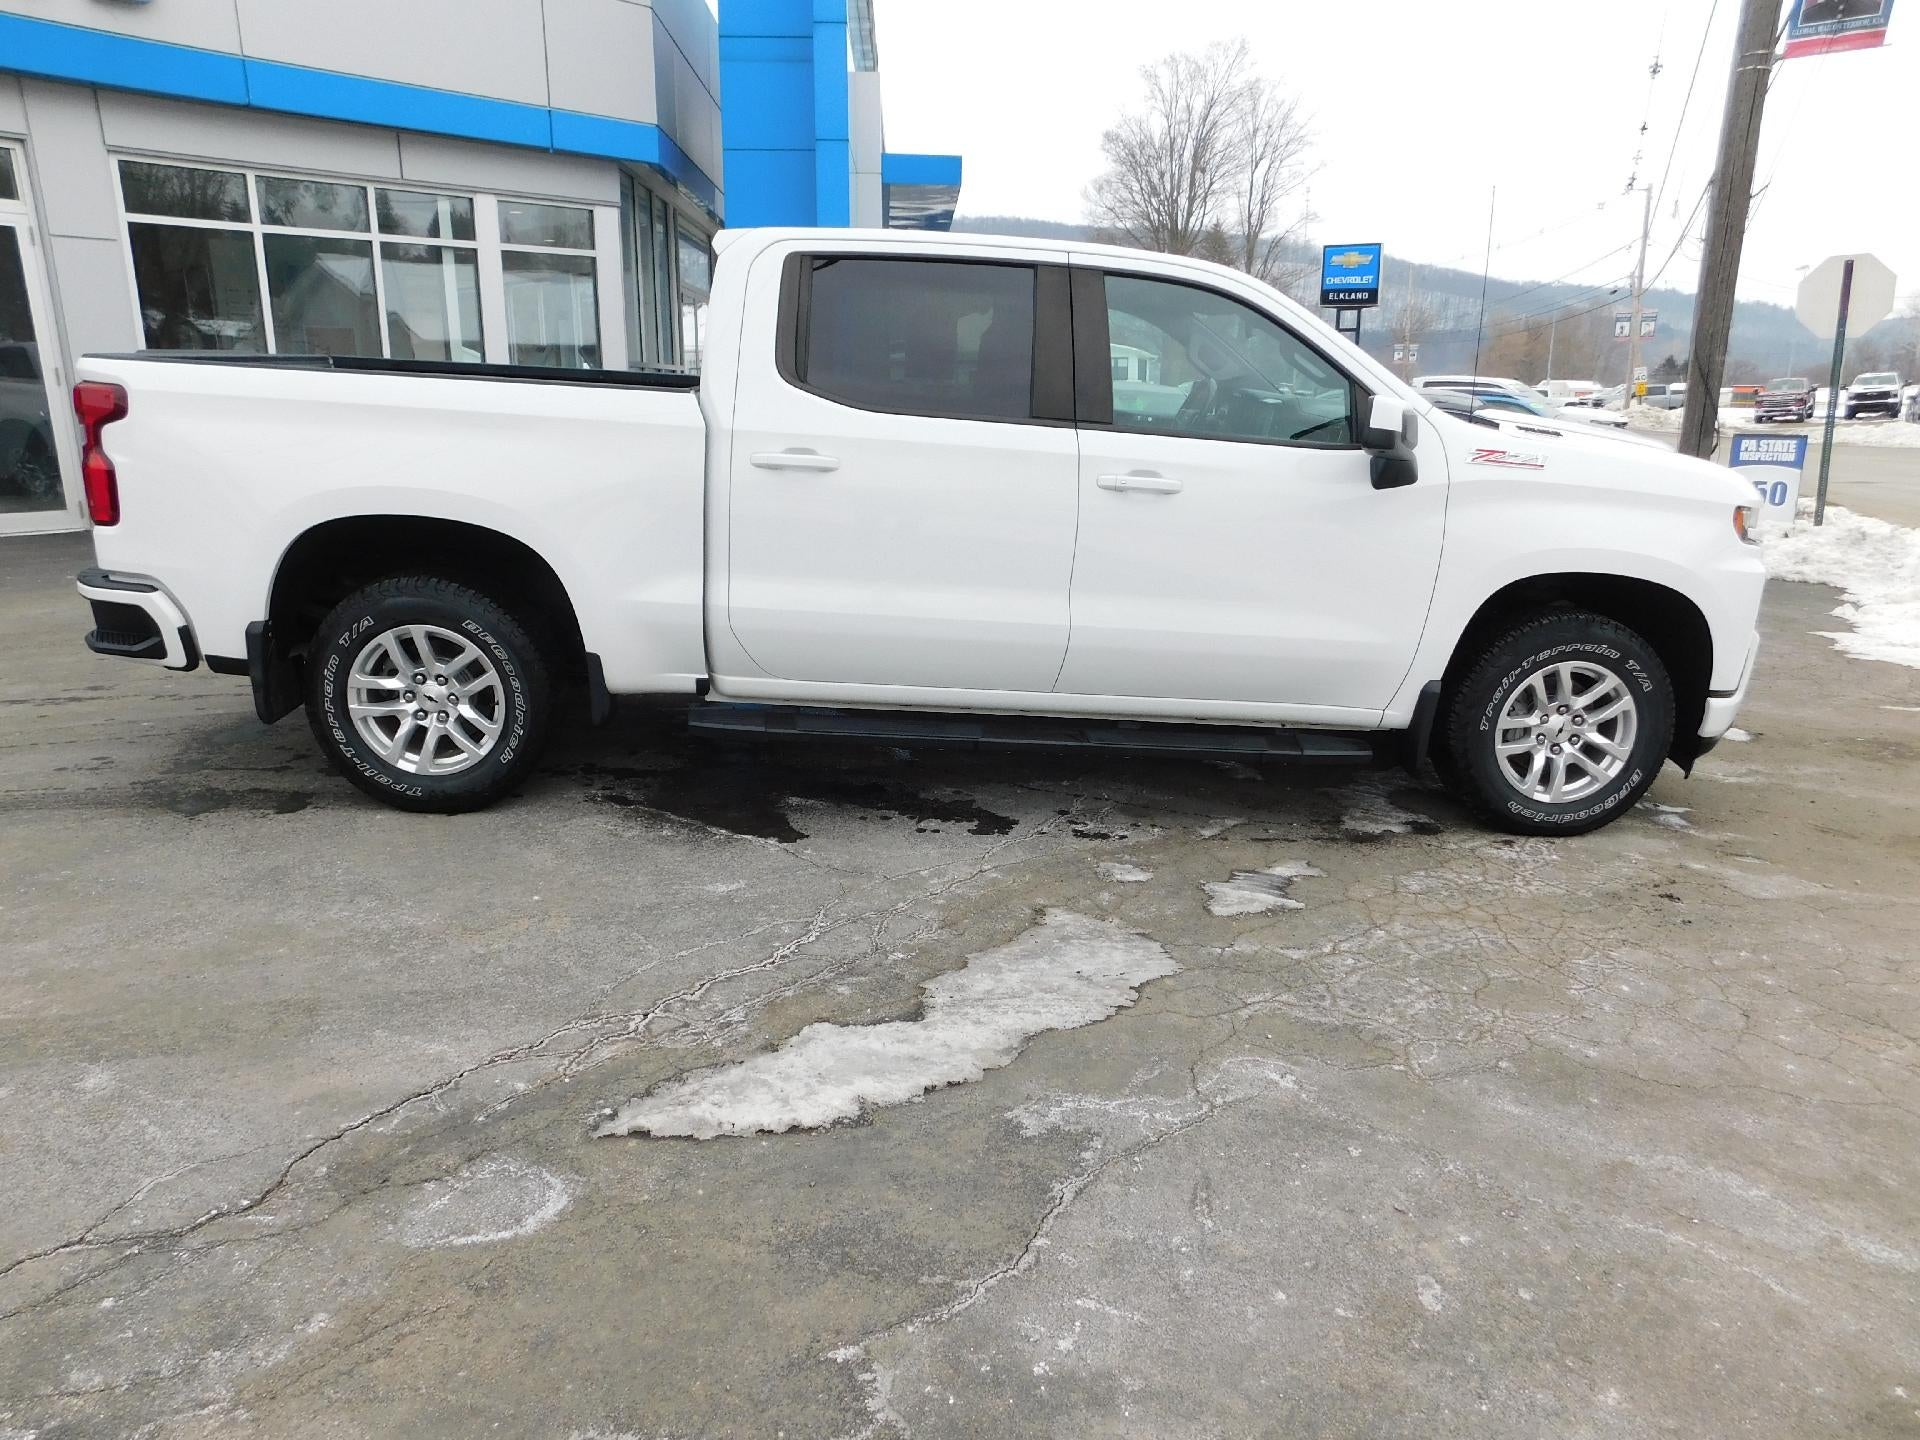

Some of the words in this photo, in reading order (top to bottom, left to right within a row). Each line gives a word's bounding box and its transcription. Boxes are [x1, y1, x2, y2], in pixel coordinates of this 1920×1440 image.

[1326, 275, 1374, 285] CHEVROLET
[1328, 292, 1369, 300] ELKLAND
[1739, 452, 1796, 462] INSPECTION
[1740, 439, 1757, 452] PA
[1758, 439, 1797, 453] STATE
[338, 616, 375, 648] T/A
[461, 619, 526, 765] BFGoodrich
[1479, 643, 1621, 732] Trail-Terrain
[1624, 659, 1653, 692] T/A
[318, 654, 423, 797] Trail-Terrain
[1507, 768, 1643, 824] BFGoodrich
